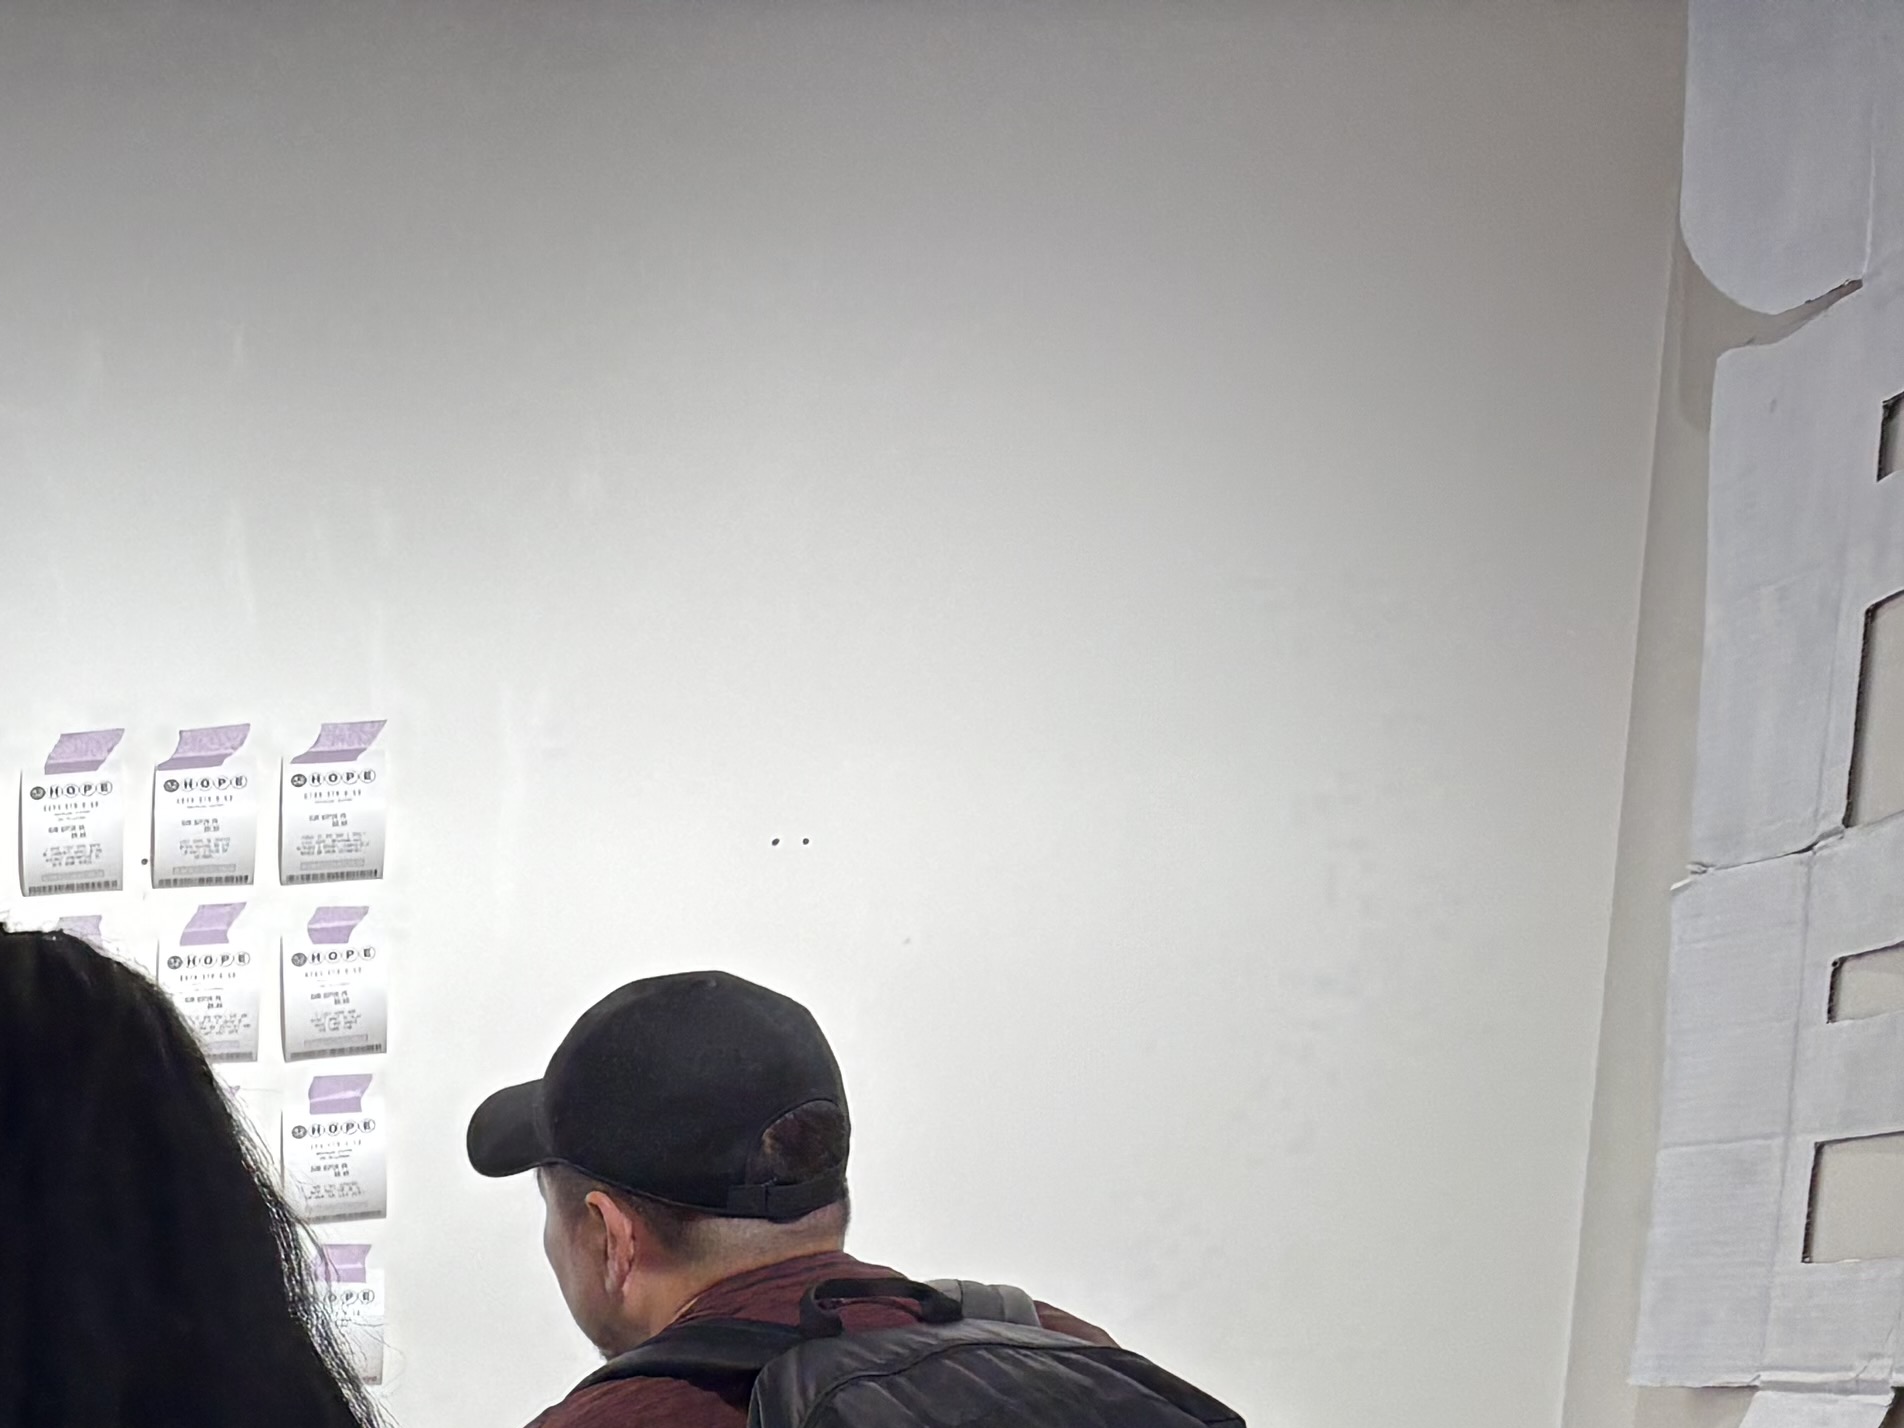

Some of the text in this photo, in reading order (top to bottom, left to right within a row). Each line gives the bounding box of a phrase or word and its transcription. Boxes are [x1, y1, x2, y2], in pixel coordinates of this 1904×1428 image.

[183, 775, 246, 792] HOPE
[310, 768, 375, 787] HOPE
[48, 781, 112, 799] HOPE
[186, 952, 249, 969] HOPE
[310, 947, 374, 965] HOPE
[310, 1120, 374, 1138] HOPE
